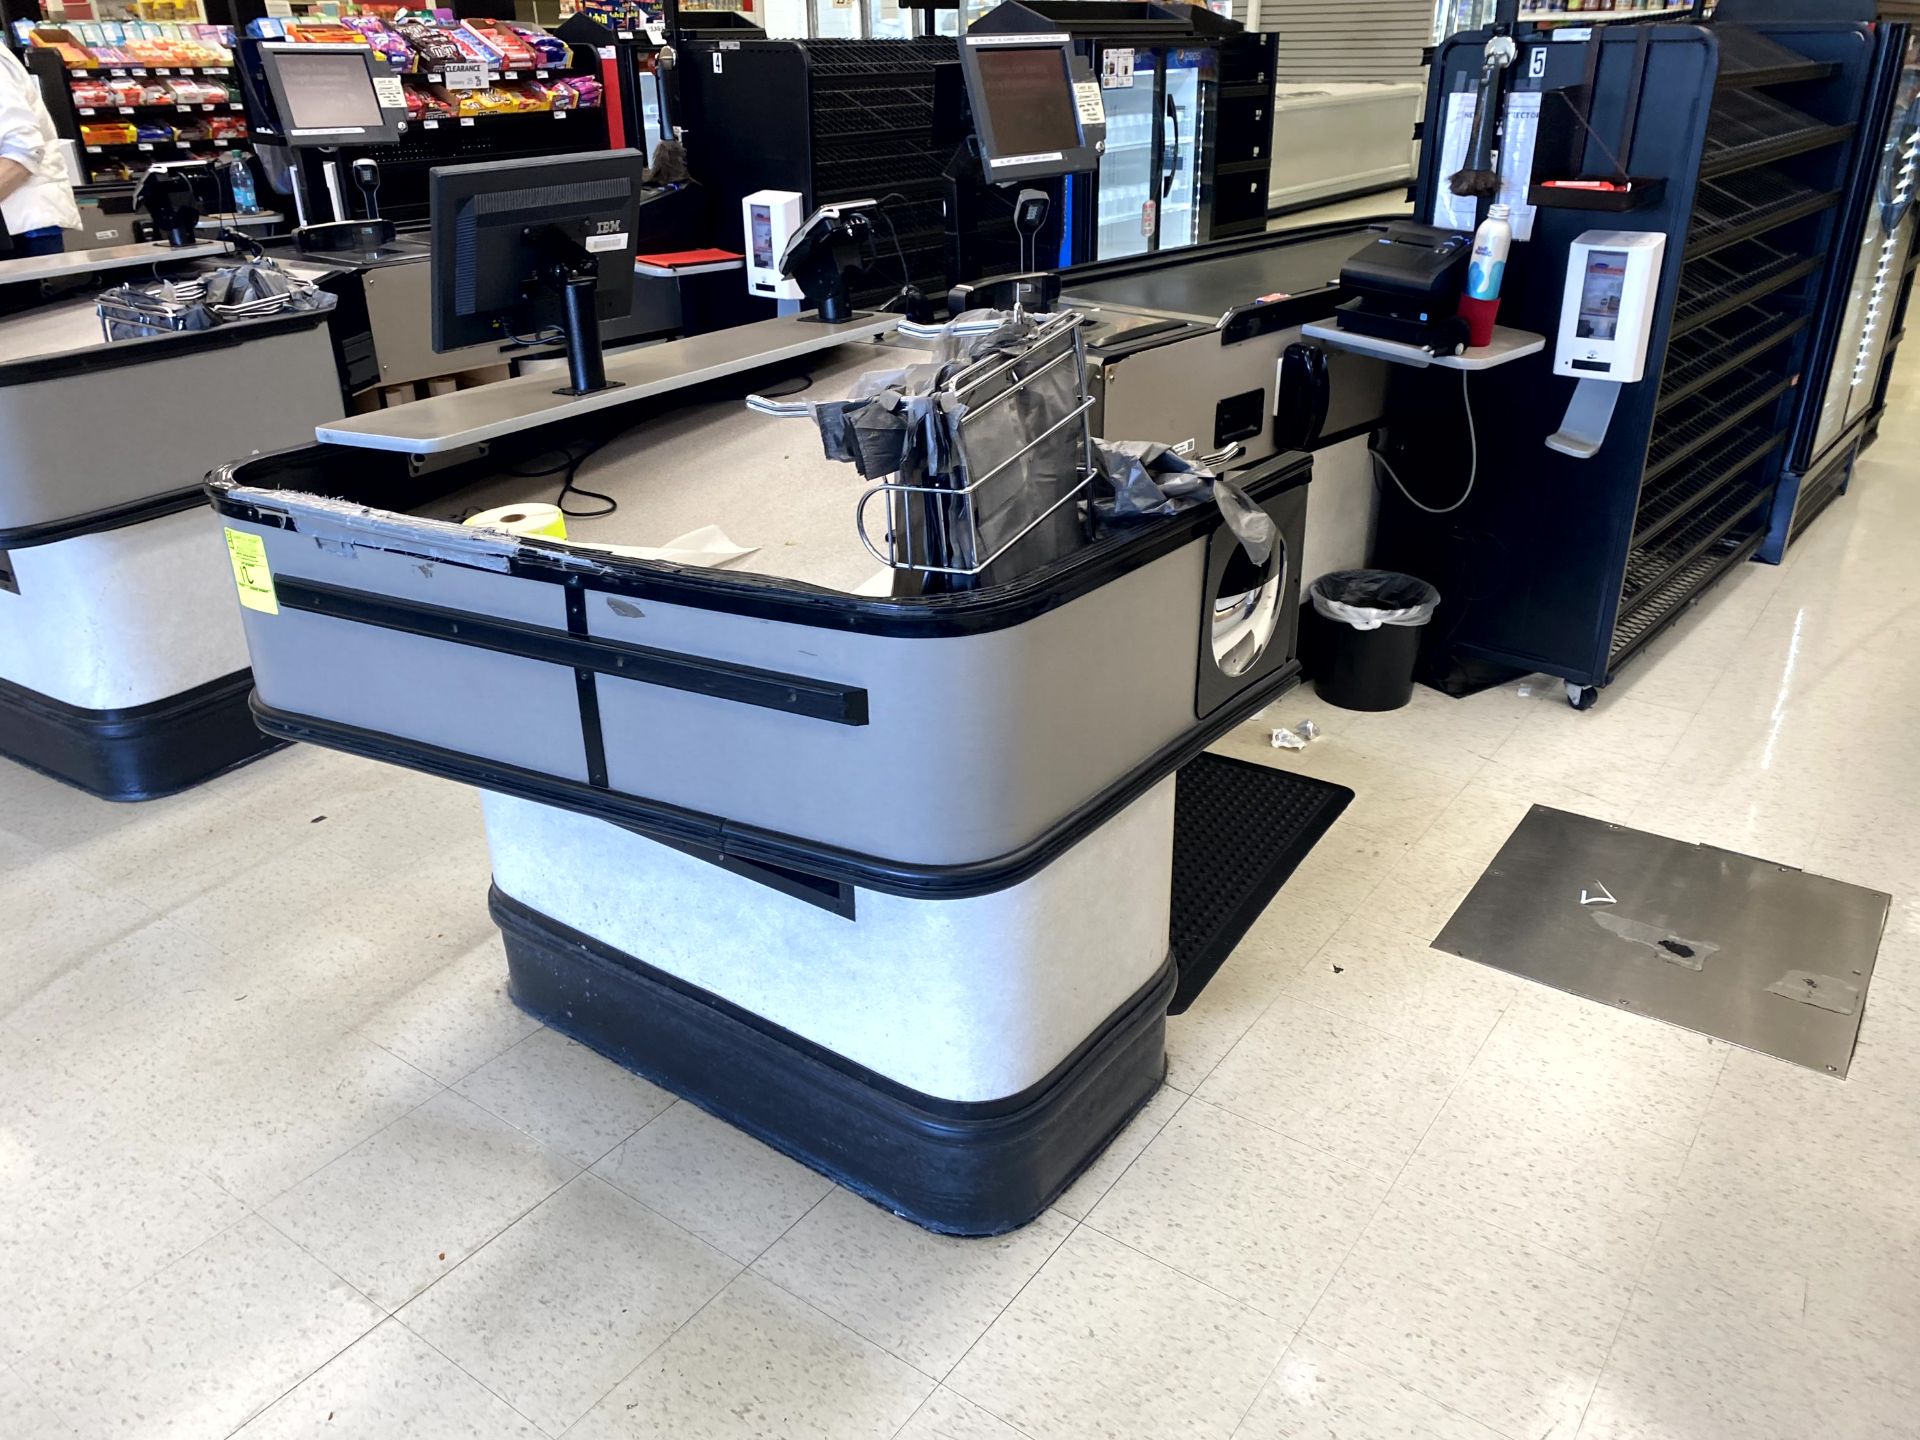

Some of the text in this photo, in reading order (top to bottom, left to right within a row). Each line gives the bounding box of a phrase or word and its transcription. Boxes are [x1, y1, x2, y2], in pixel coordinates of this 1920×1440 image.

[445, 64, 481, 73] CLEARANCE
[715, 53, 721, 72] 4
[1532, 50, 1545, 75] 5
[596, 220, 621, 234] IBM
